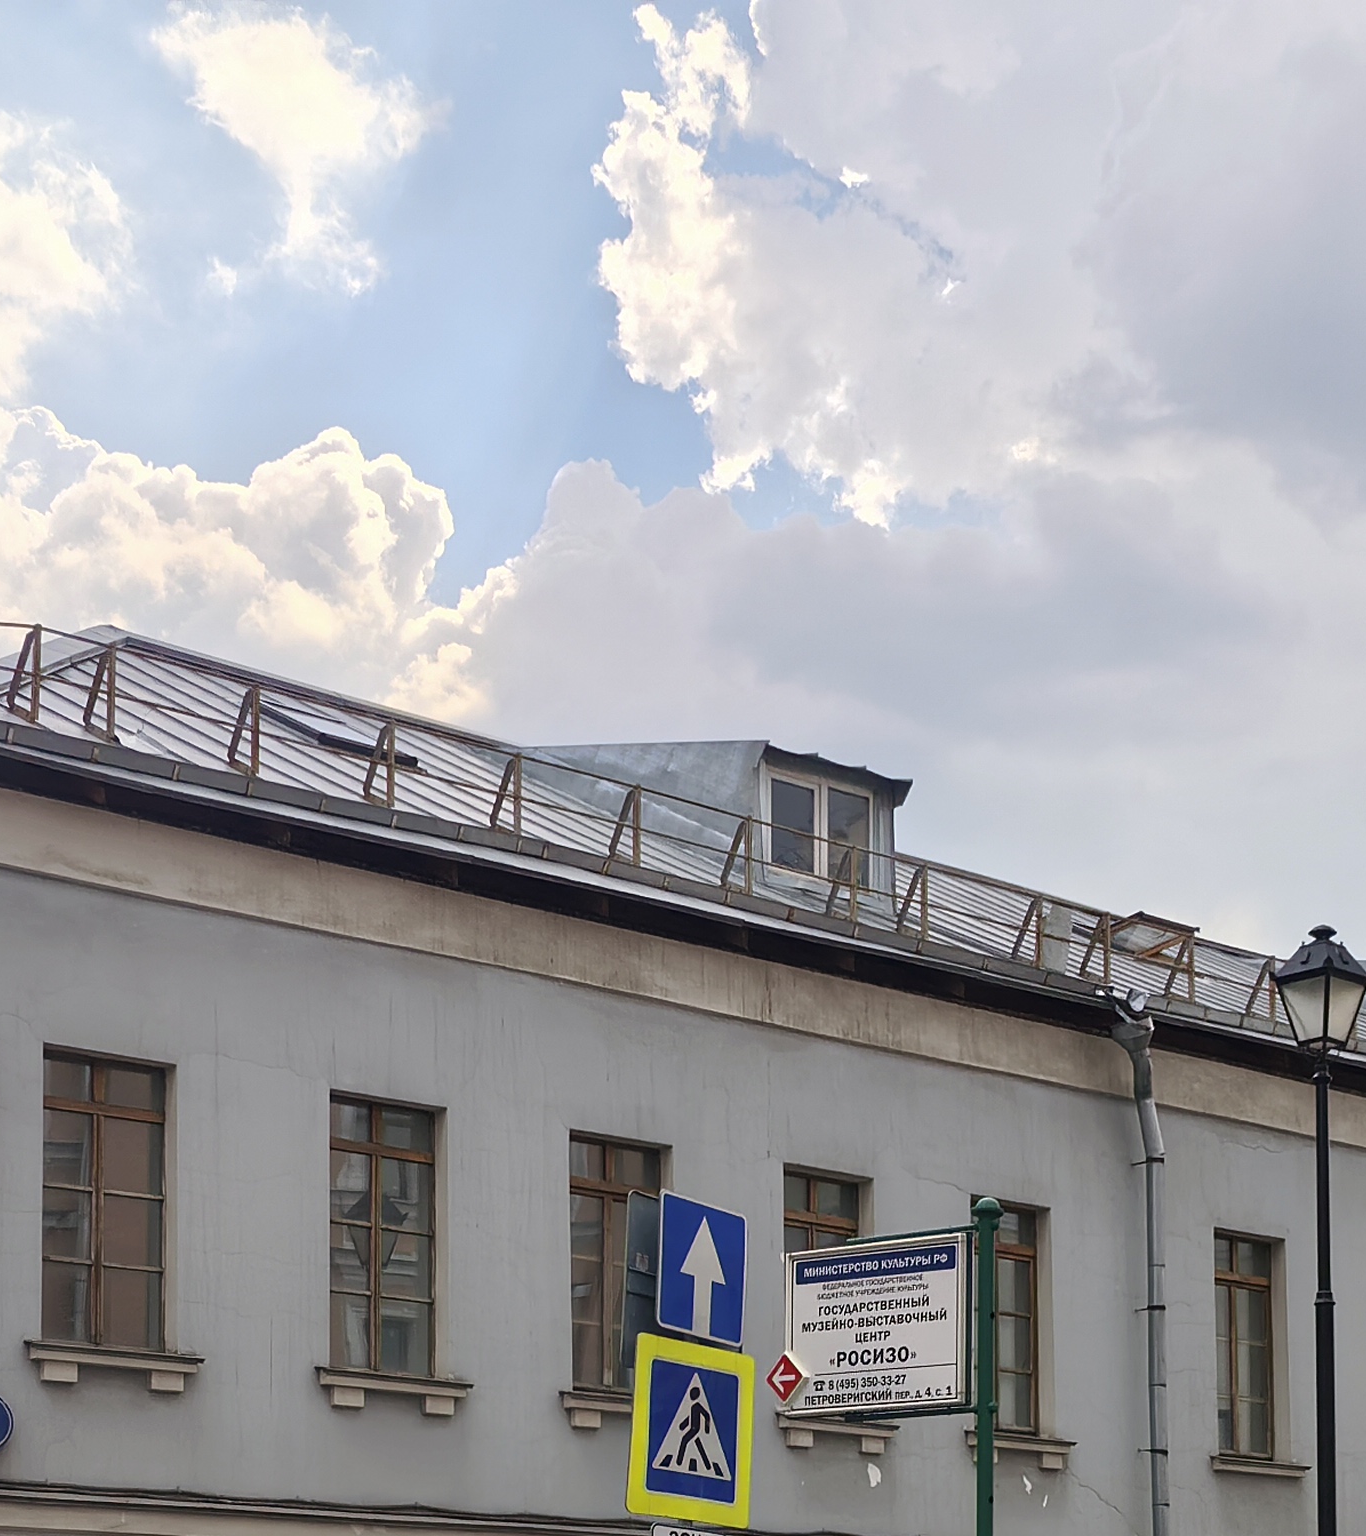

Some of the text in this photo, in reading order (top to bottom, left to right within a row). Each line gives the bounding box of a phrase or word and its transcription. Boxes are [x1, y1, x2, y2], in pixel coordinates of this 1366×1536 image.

[803, 1253, 948, 1278] МИНИСТЕРСТВО КУЛЬТУРЫ РФ
[818, 1294, 930, 1317] ГОСУДАРСТВЕННЫЙ
[801, 1308, 948, 1333] МУЗЕЙНО-ВЫСТАВОЧНЫЙ
[855, 1331, 891, 1344] ЦЕНТР
[829, 1346, 917, 1367] «РОСИЗО»
[828, 1374, 906, 1391] 8 (495) 350-33-27
[804, 1388, 892, 1406] ПЕТРОВЕРИГСКИЙ
[946, 1386, 953, 1396] 1
